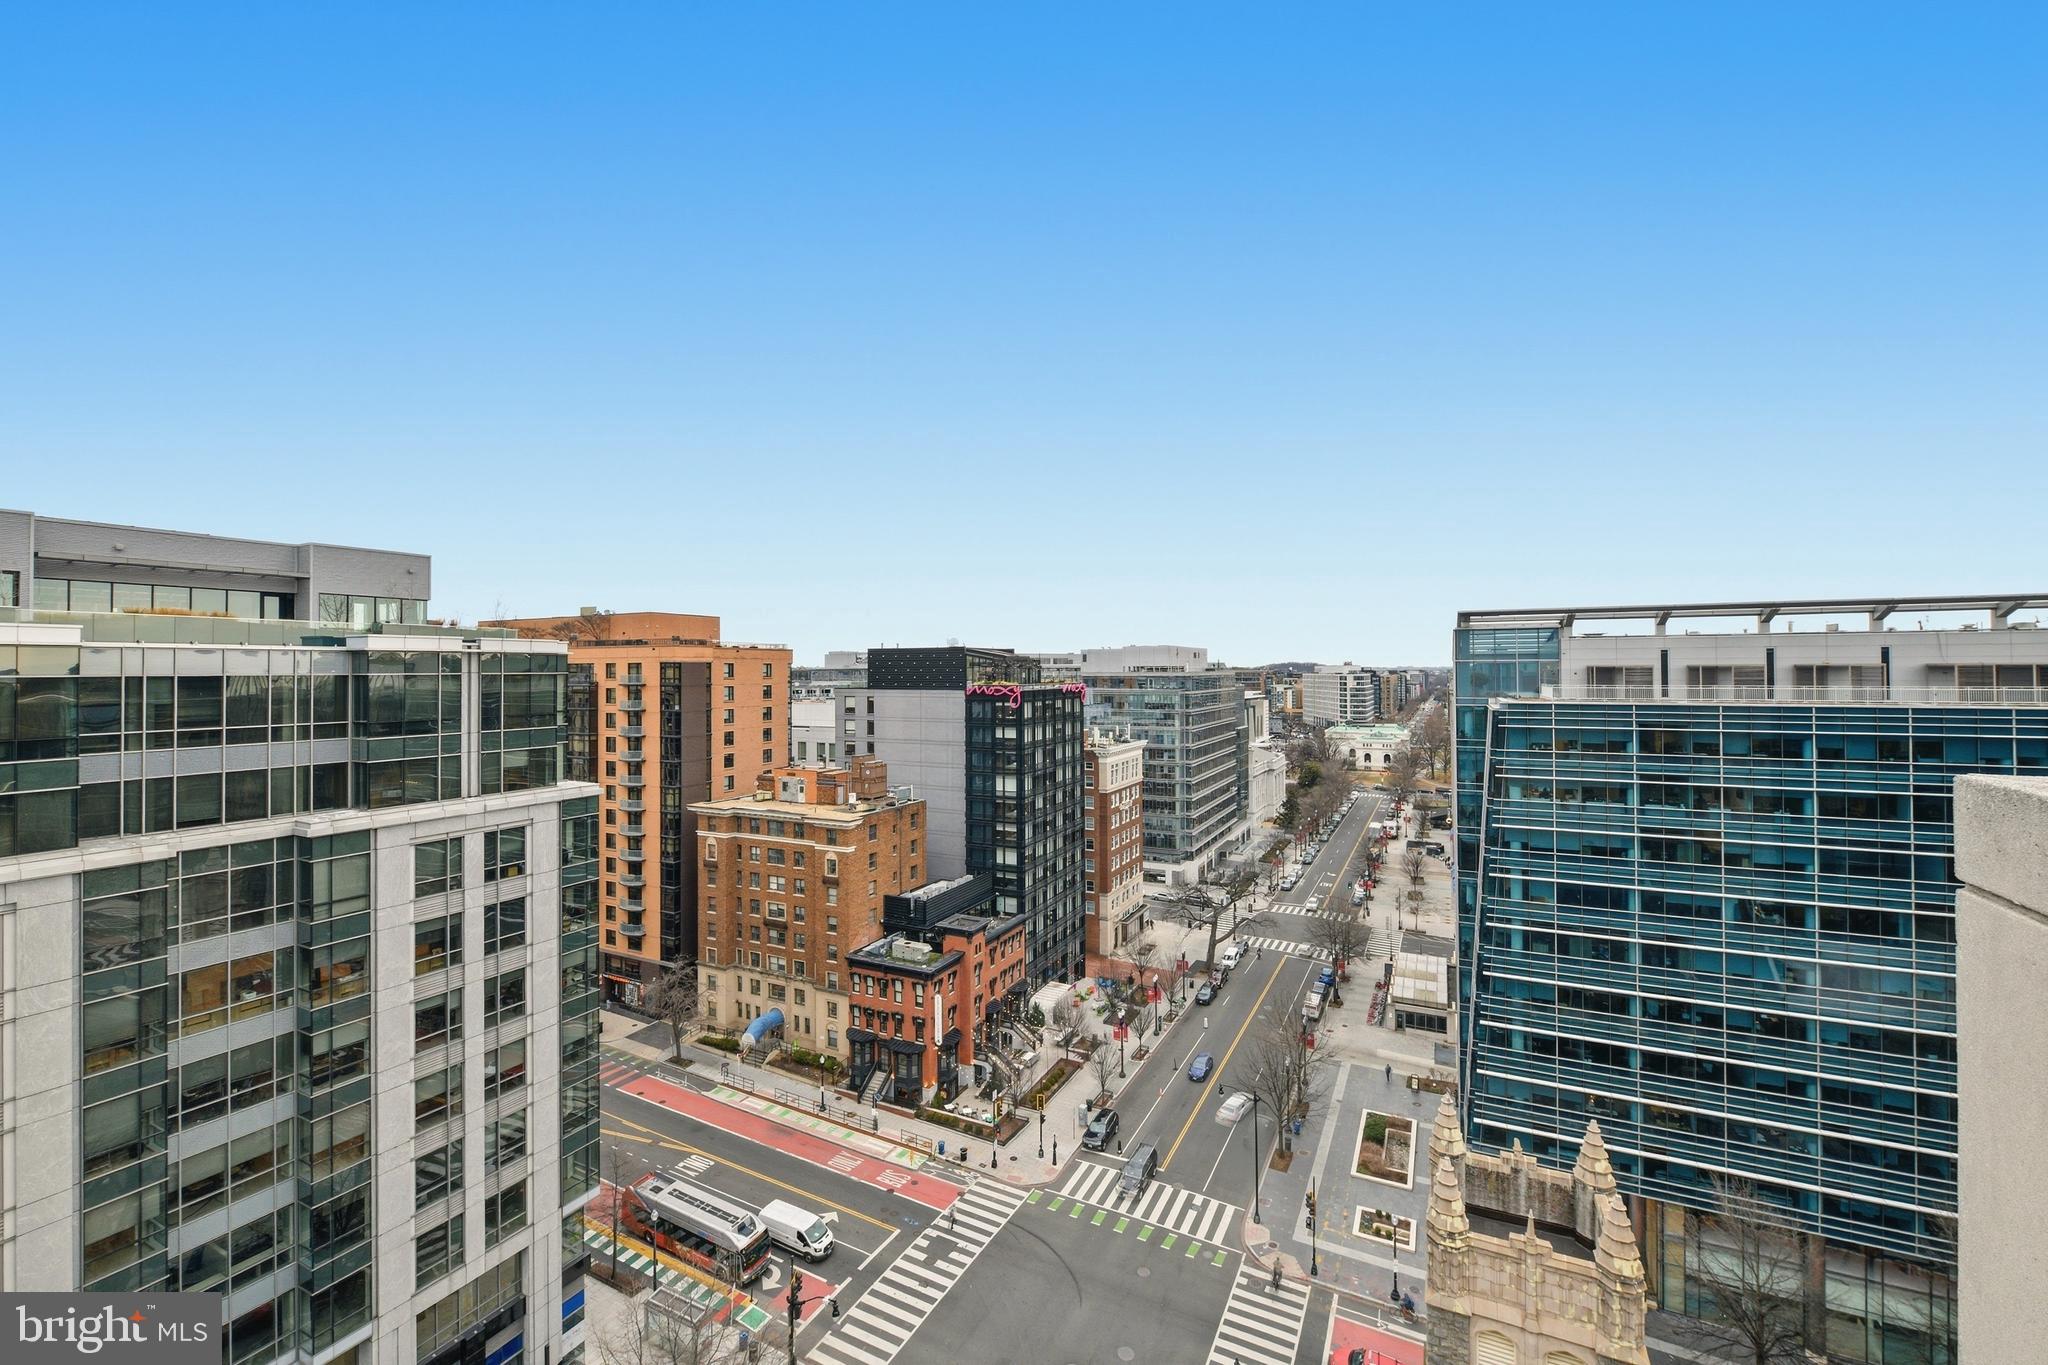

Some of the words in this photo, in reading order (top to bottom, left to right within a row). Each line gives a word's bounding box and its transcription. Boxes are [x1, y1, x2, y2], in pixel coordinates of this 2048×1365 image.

[966, 685, 1022, 709] moxy
[674, 1154, 716, 1177] ONLY
[827, 1150, 865, 1172] ONLY
[875, 1169, 912, 1188] BUS
